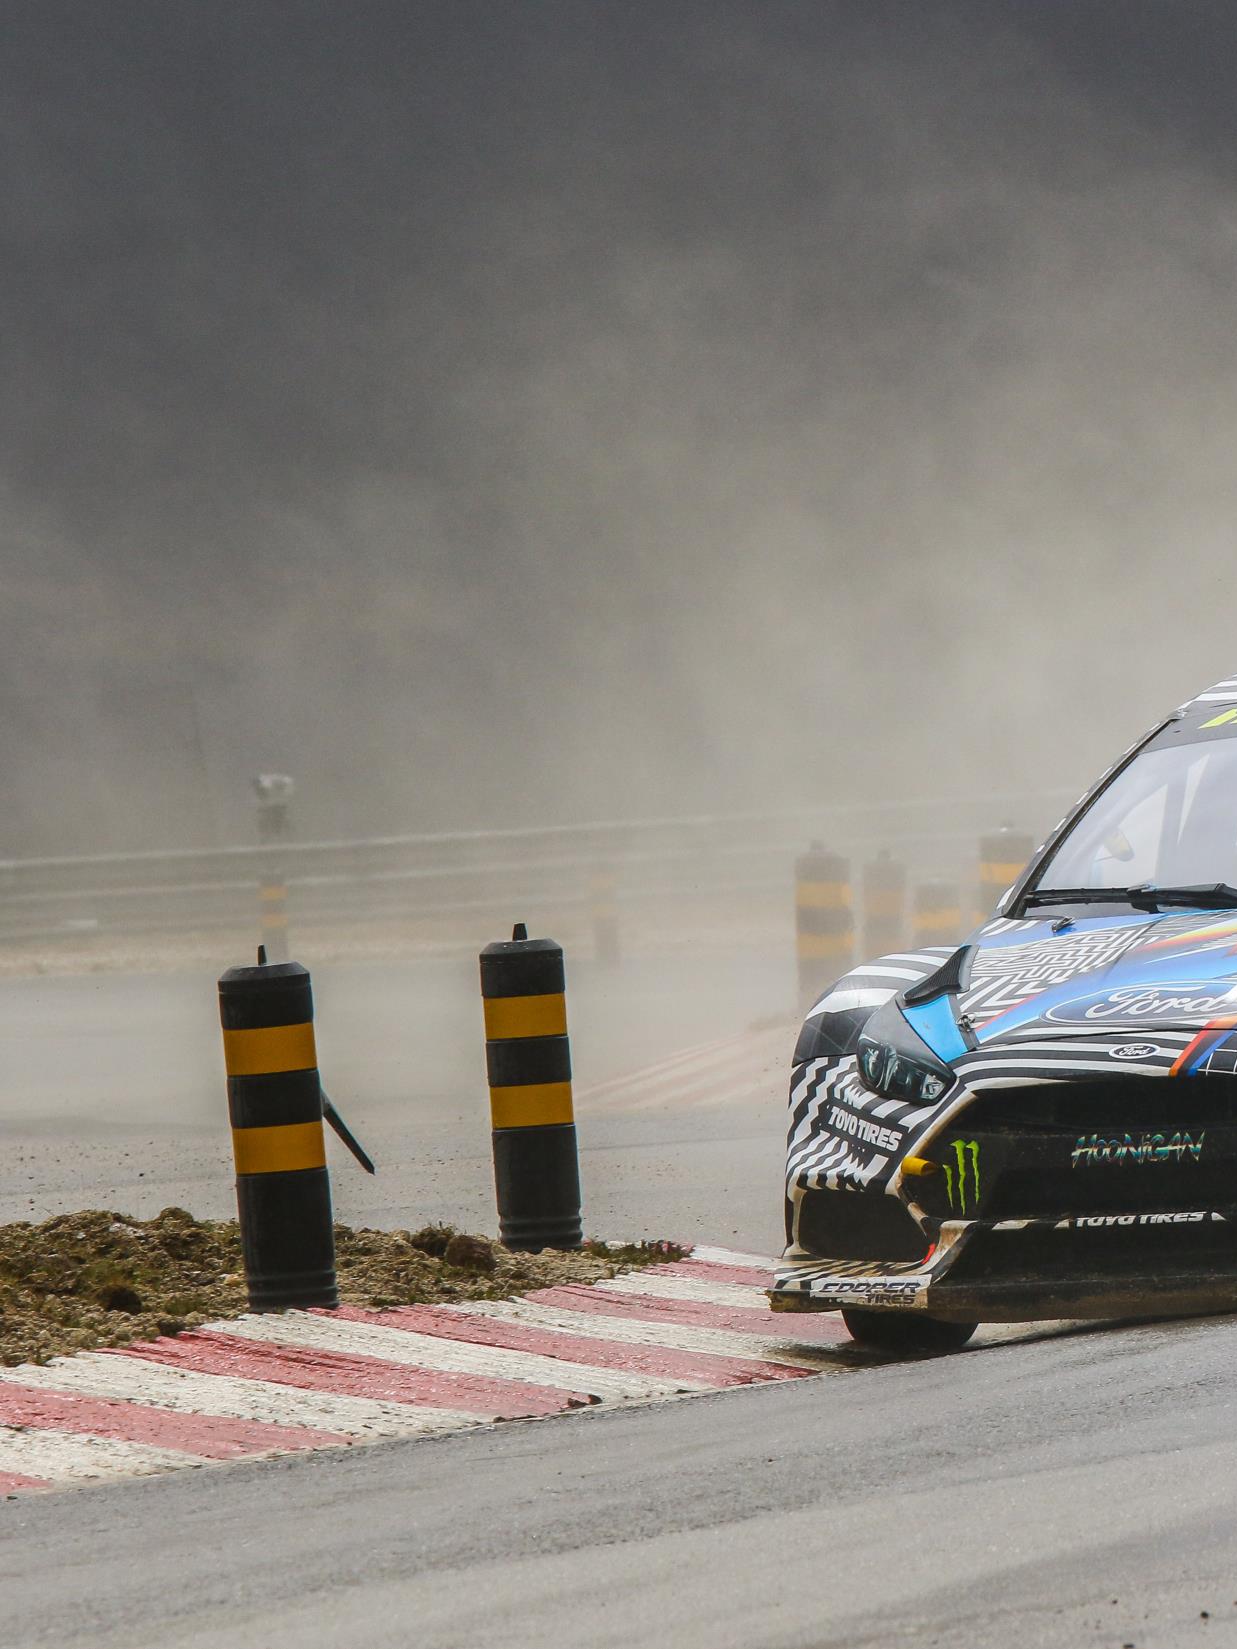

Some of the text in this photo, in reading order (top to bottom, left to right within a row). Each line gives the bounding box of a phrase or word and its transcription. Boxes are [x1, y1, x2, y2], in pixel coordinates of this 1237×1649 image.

[1119, 1046, 1151, 1057] Ford
[828, 1106, 903, 1152] TOYO TIRES
[1076, 1212, 1207, 1228] TOYO TIRES
[819, 1282, 921, 1293] COOPER
[865, 1293, 916, 1304] TIRES
